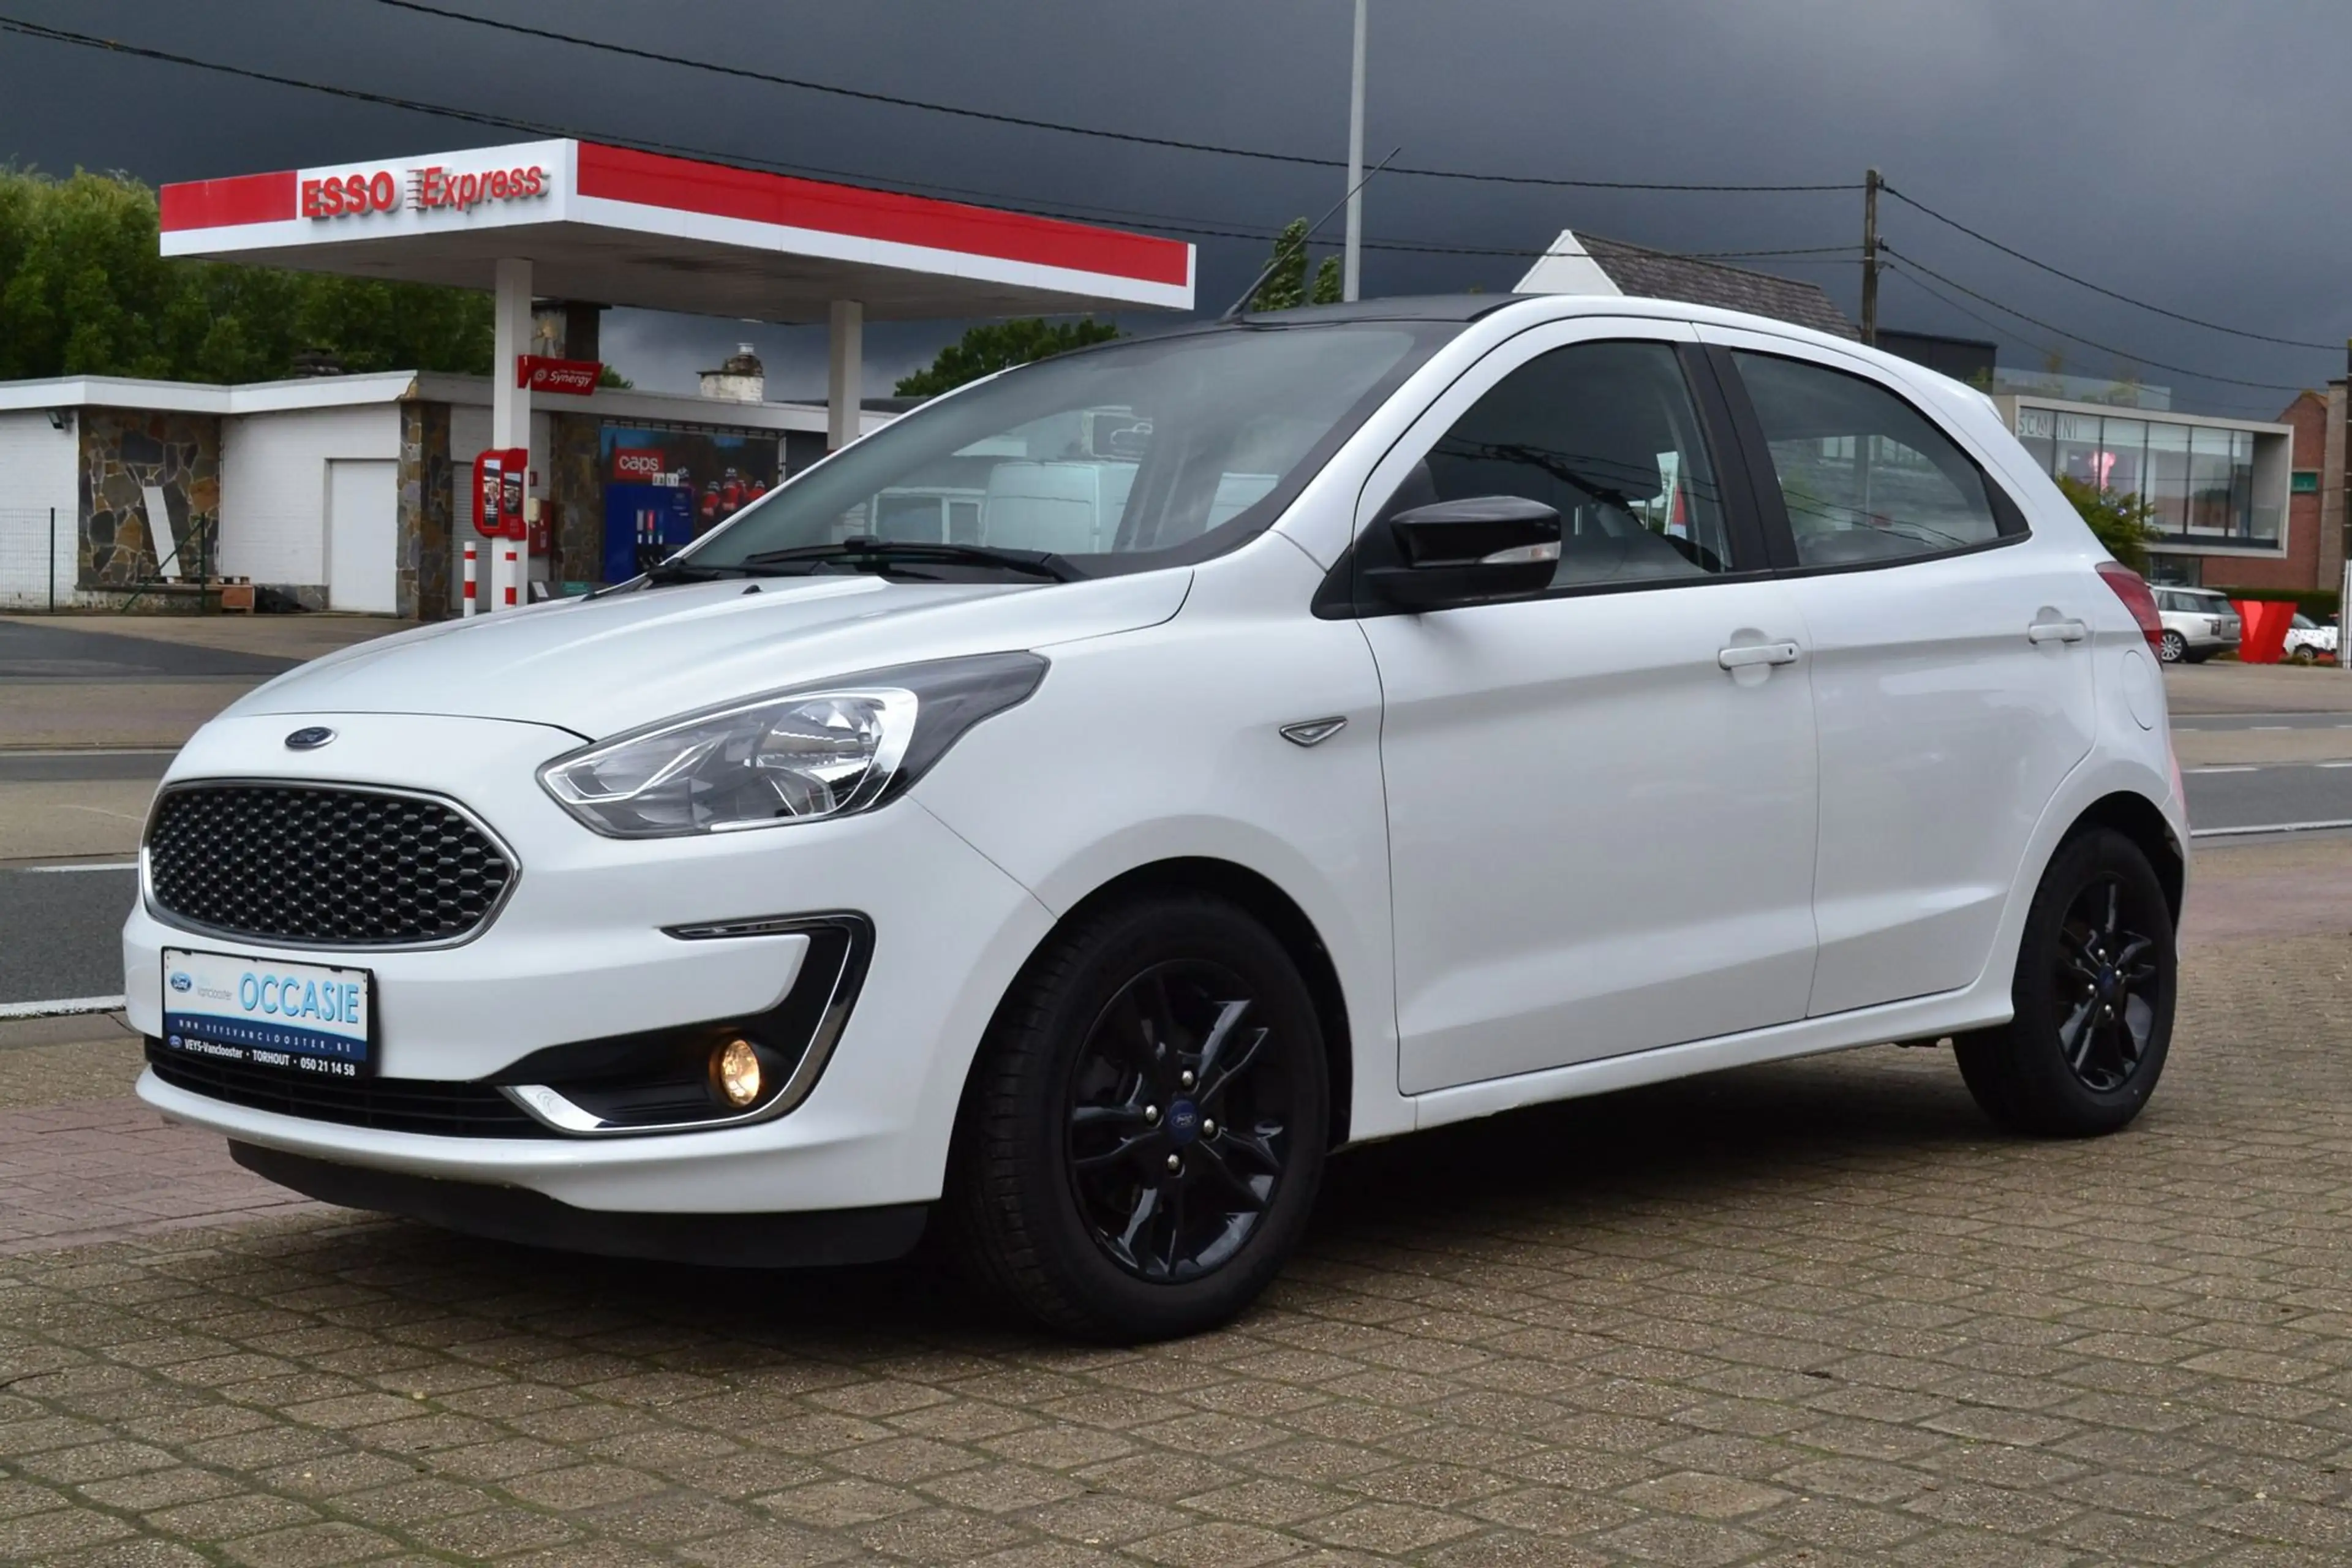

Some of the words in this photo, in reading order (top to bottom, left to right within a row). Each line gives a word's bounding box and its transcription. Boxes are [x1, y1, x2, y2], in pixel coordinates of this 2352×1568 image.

[302, 170, 395, 217] ESSO
[421, 166, 542, 211] Express
[549, 371, 592, 387] Synergy
[619, 455, 659, 475] caps
[239, 972, 359, 1023] OCCASIE
[184, 1039, 243, 1058] VEYS-Vanclooster
[252, 1049, 291, 1066] TORHOUT
[300, 1059, 317, 1071] 050
[318, 1061, 328, 1072] 21
[331, 1063, 341, 1075] 14
[343, 1065, 355, 1077] 58
